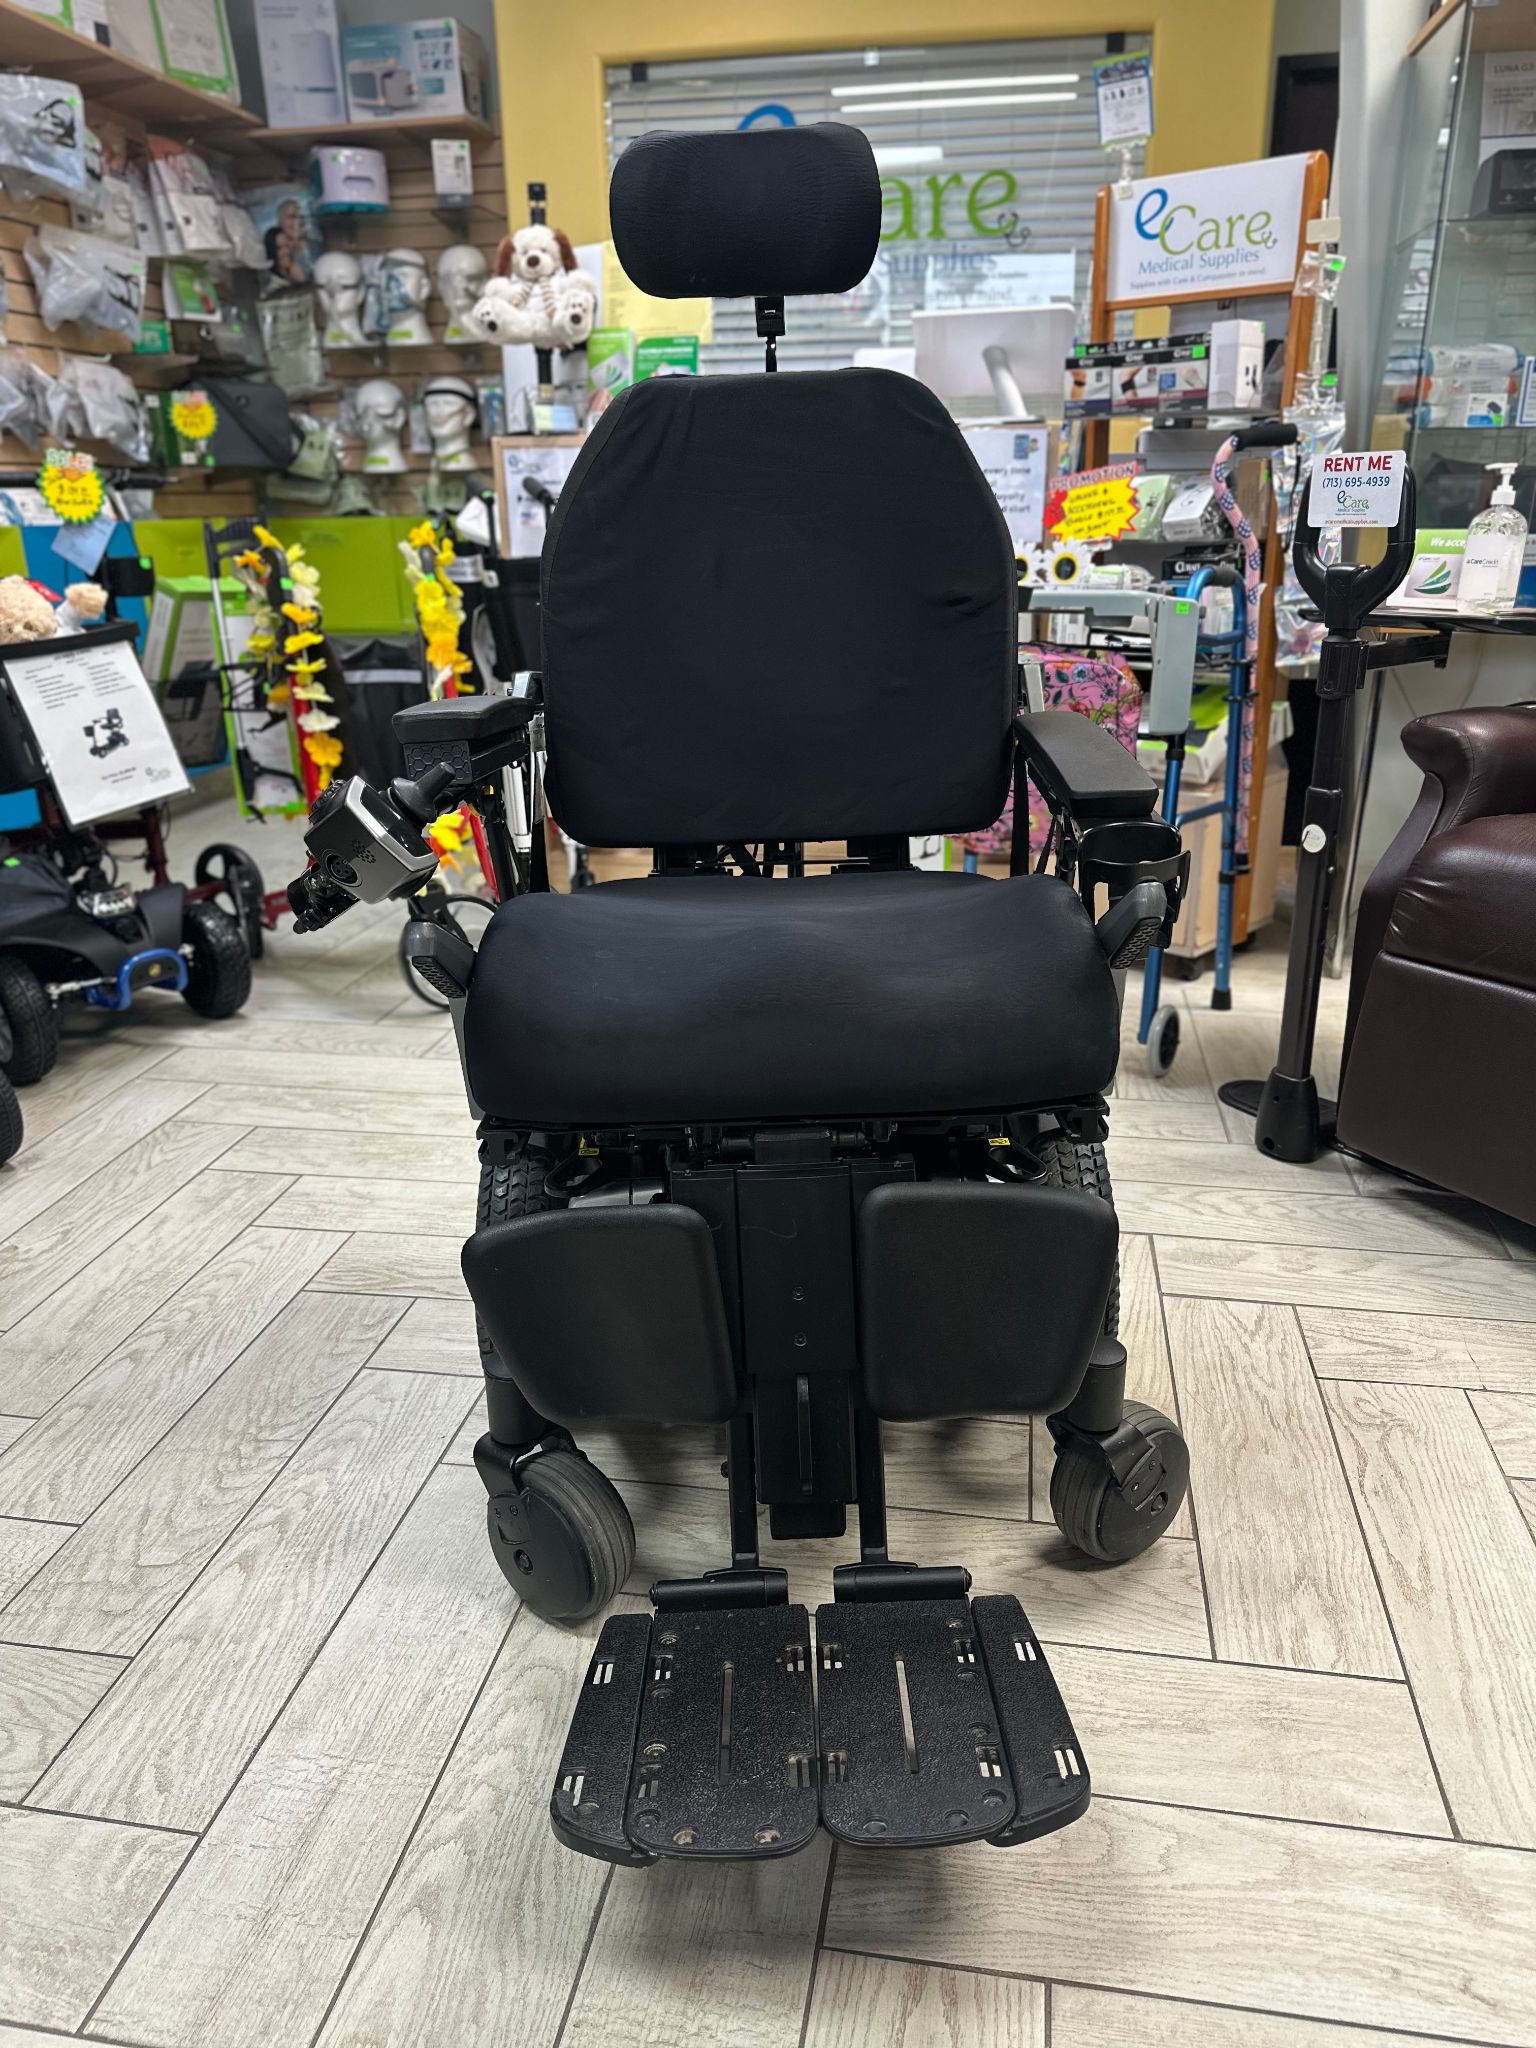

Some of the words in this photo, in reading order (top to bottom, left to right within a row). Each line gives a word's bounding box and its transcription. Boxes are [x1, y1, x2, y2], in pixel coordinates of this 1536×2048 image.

[1135, 187, 1273, 255] eCare
[1137, 254, 1194, 275] Medical
[1200, 248, 1260, 270] Supplies
[1323, 457, 1364, 472] RENT
[1367, 455, 1393, 471] ME
[1050, 465, 1133, 489] PROMOTION
[1322, 477, 1342, 488] (713)
[1345, 476, 1390, 487] 695-4939
[1430, 537, 1444, 547] We
[1445, 538, 1466, 548] acce
